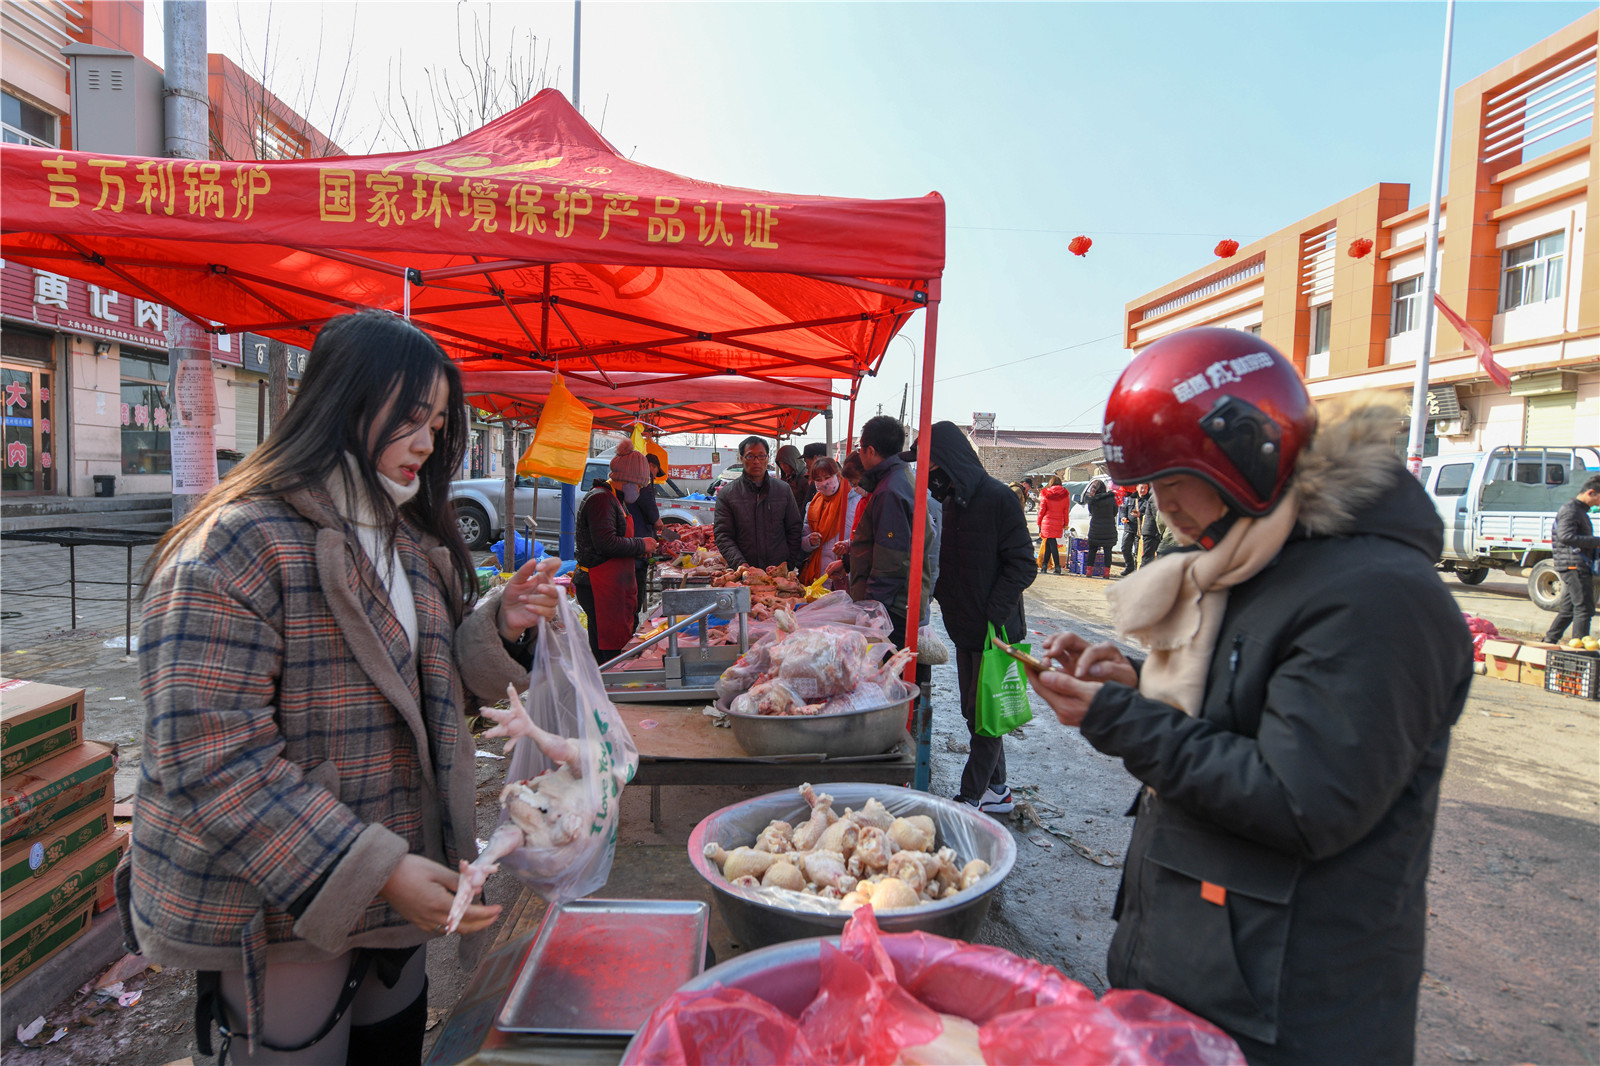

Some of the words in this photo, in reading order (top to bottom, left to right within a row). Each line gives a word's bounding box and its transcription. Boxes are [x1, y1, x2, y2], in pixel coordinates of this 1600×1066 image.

[41, 154, 272, 220] 吉万利锅炉
[319, 169, 781, 251] 国家环境保护产品认证
[6, 380, 28, 468] 大肉
